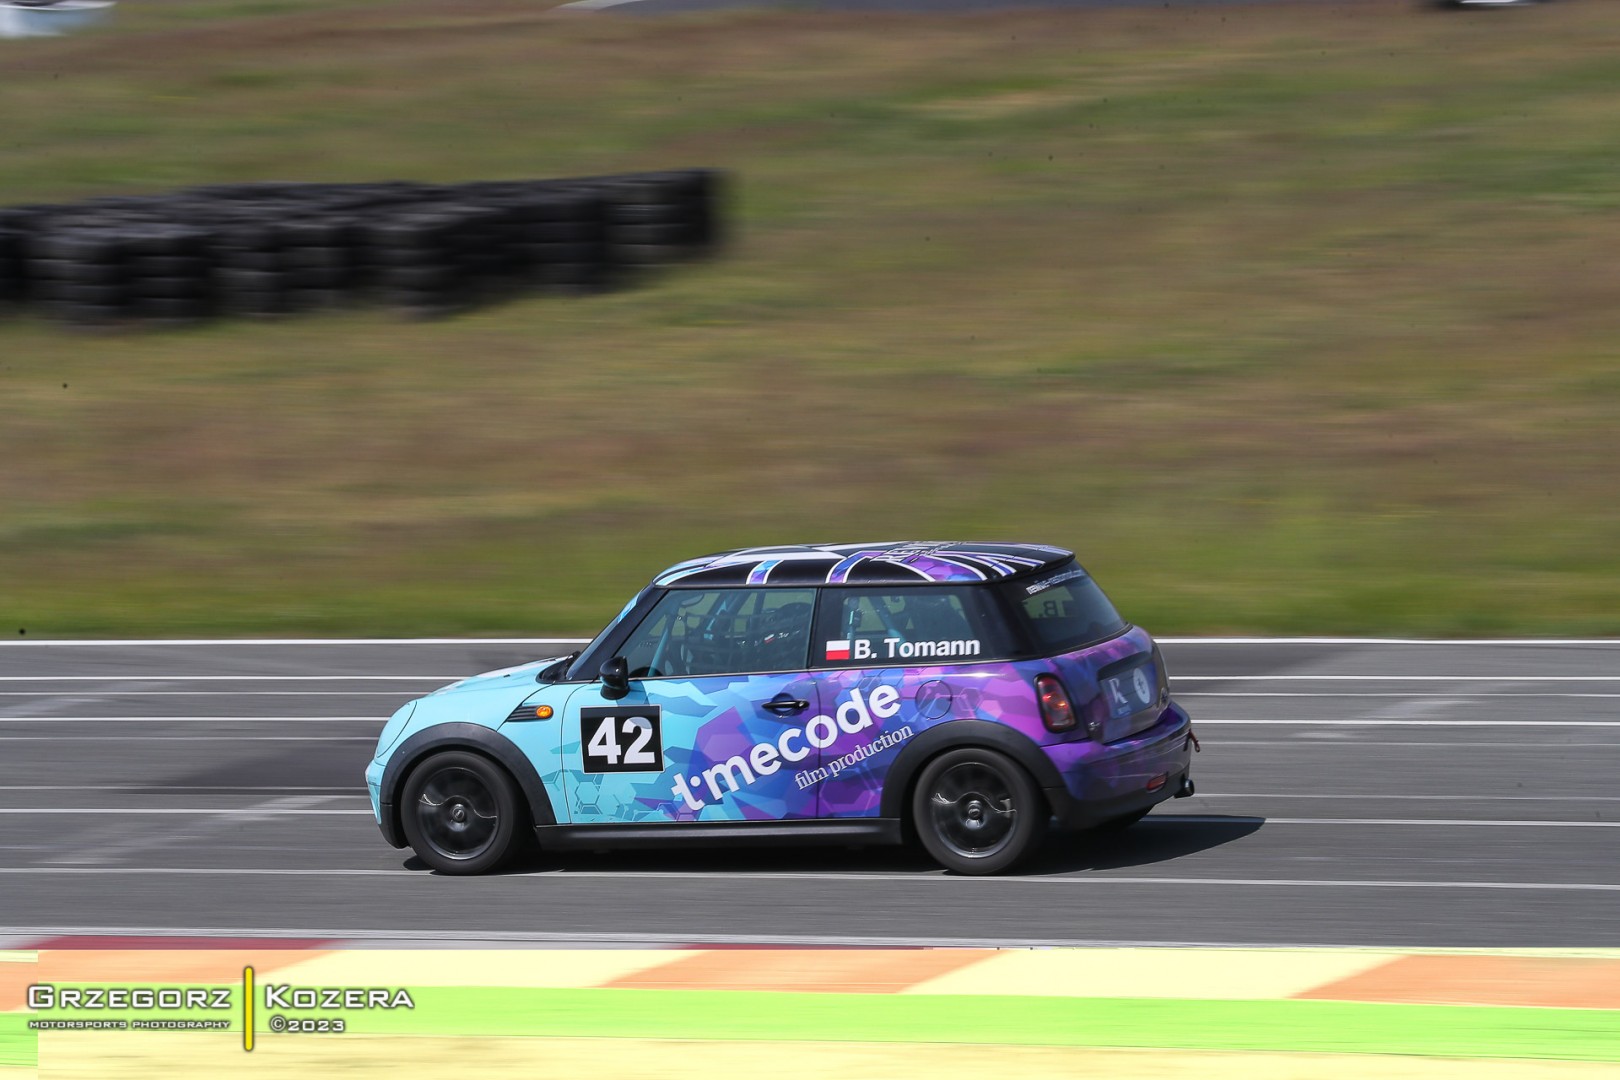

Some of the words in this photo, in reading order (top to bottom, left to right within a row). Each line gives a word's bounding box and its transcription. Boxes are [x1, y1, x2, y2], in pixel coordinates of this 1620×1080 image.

[854, 639, 877, 659] B.
[884, 637, 980, 658] Tomann
[588, 716, 656, 764] 42
[794, 766, 829, 791] film
[826, 725, 914, 777] production
